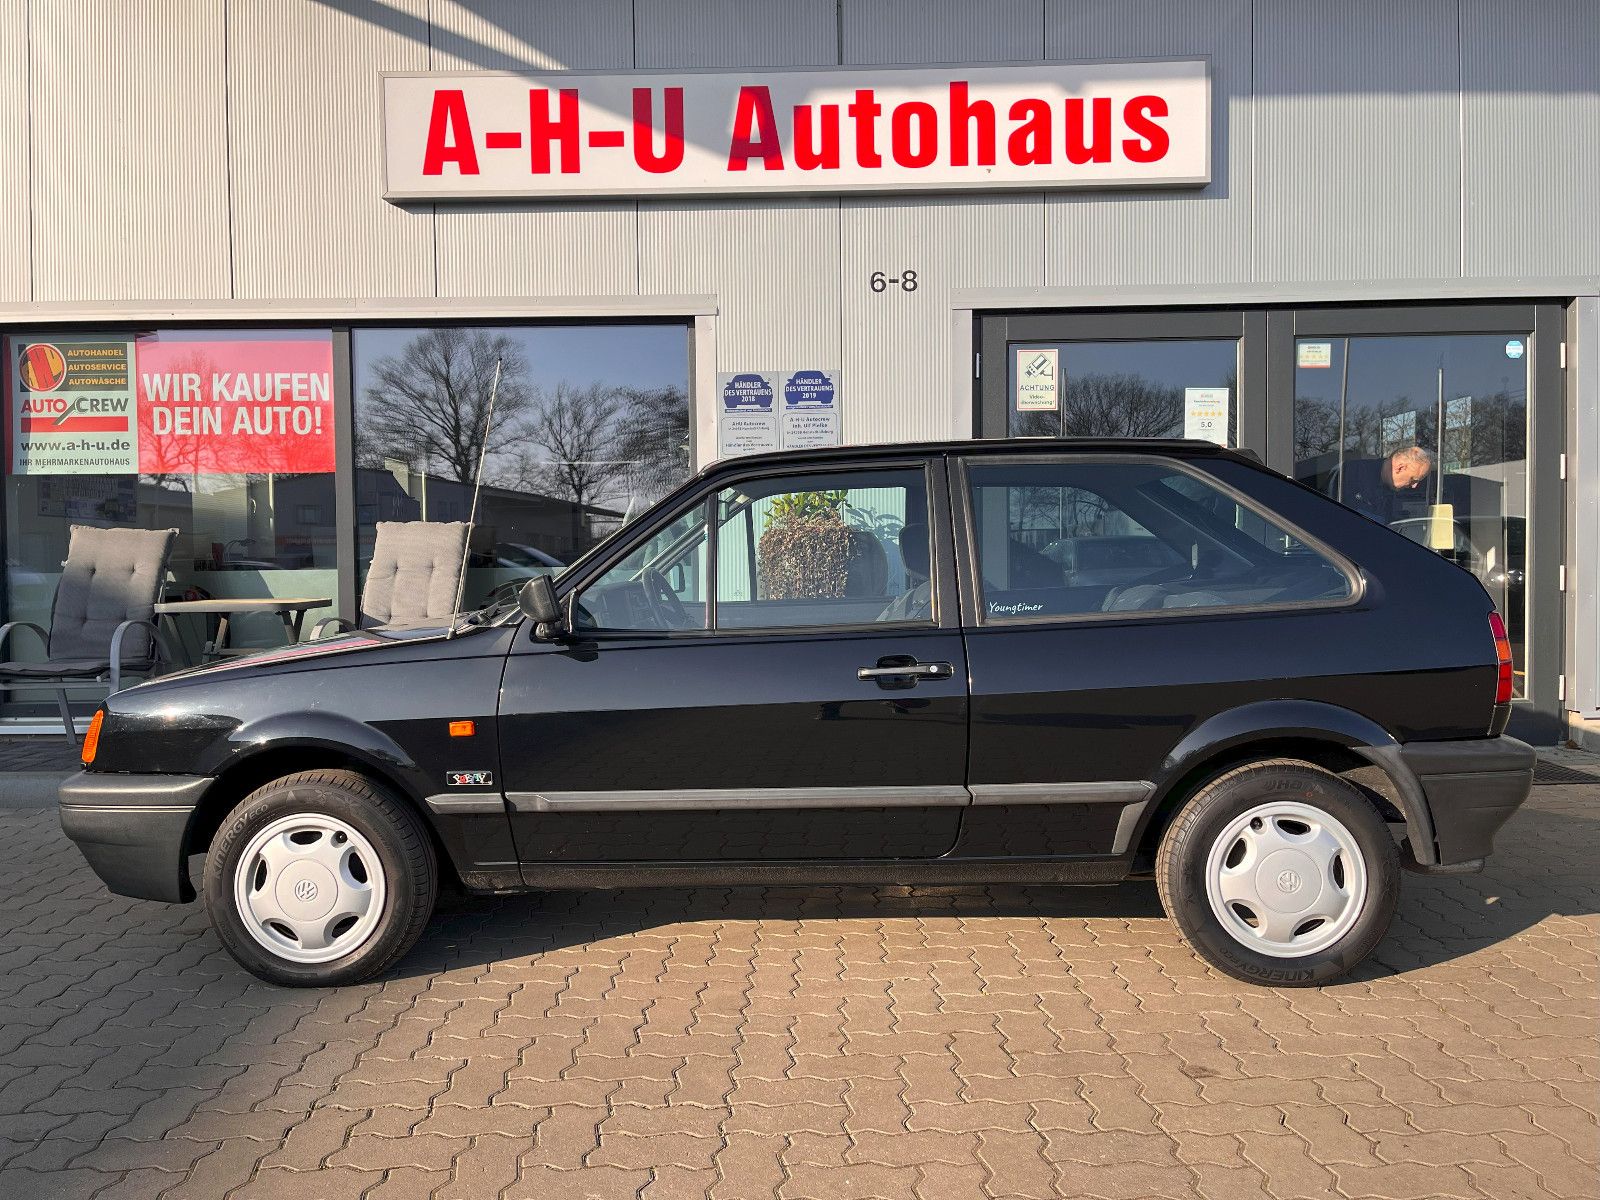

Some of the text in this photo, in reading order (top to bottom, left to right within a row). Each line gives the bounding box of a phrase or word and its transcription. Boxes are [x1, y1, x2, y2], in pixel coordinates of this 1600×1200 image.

[423, 80, 1171, 176] A-H-U Autohaus
[869, 269, 919, 293] 6-8
[68, 363, 127, 371] AUTOSERVICE
[68, 377, 127, 385] AUTOWÄSCHE
[143, 371, 330, 402] WIR KAUFEN
[736, 388, 773, 396] VERTRAUENS
[20, 395, 130, 415] AUTO CREW
[153, 405, 322, 436] DEIN AUTO!
[20, 438, 131, 452] www.a-h-u.de
[19, 458, 131, 466] IHR MEHRMARKENAUTOHAUS
[988, 601, 1044, 615] Youngtimer
